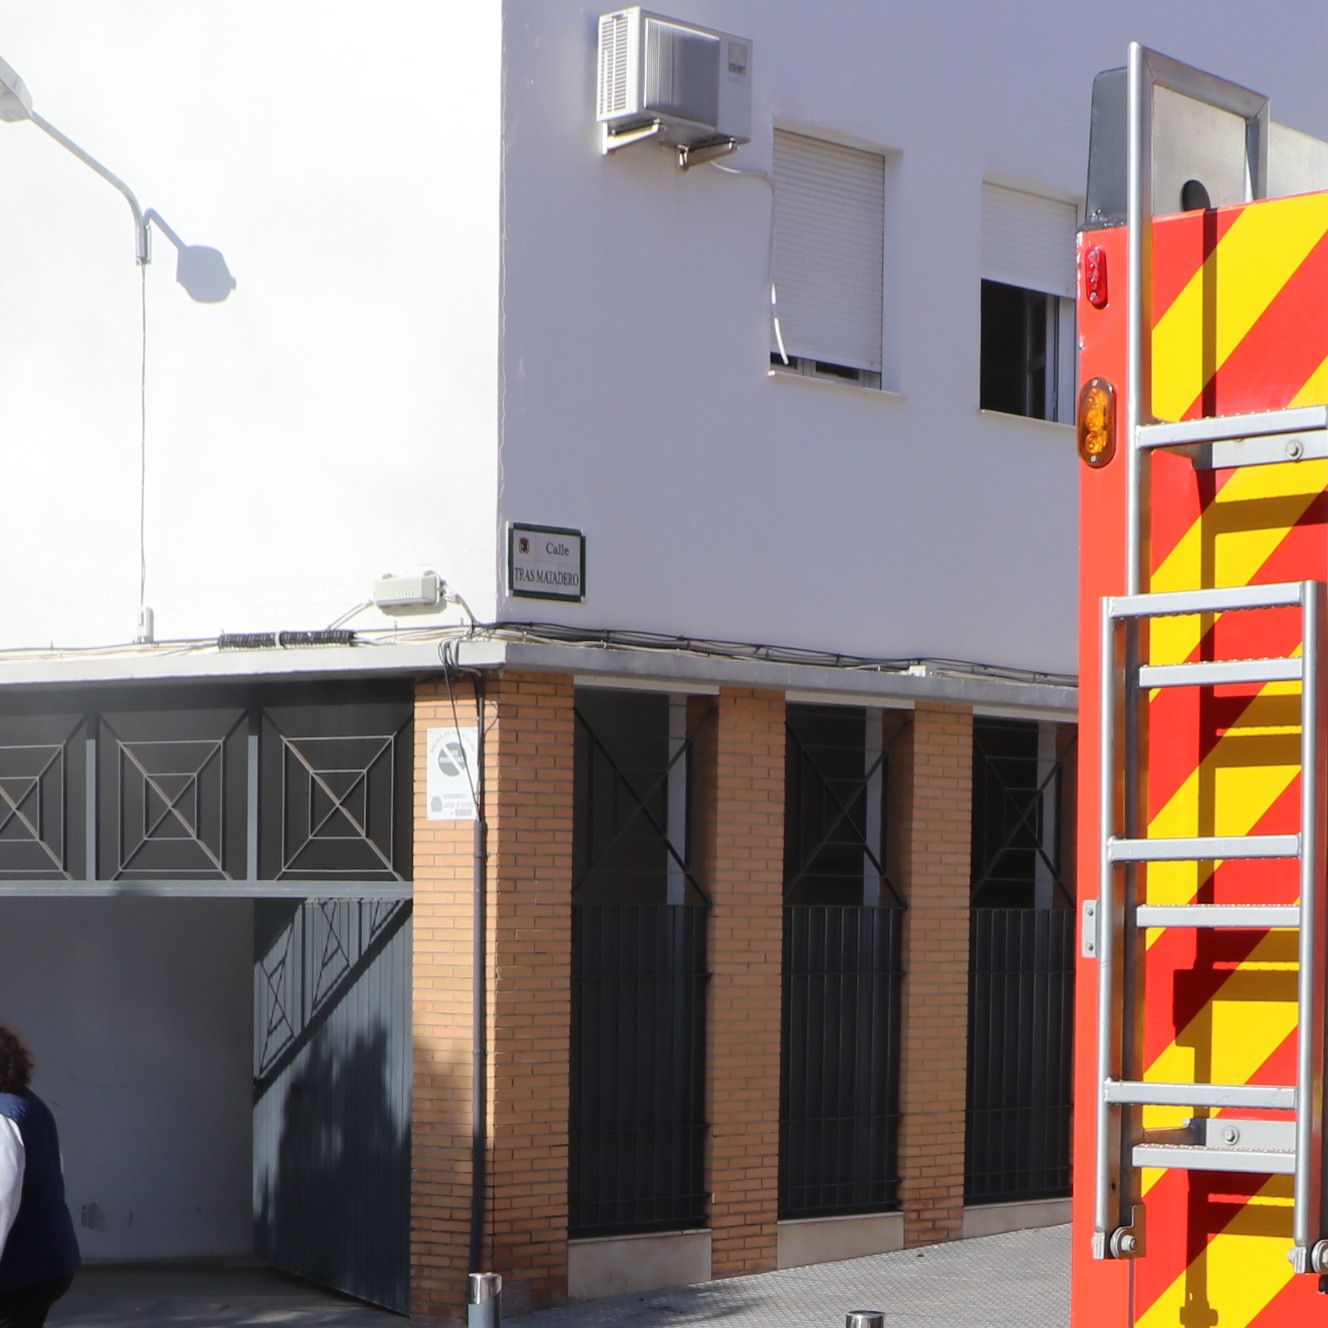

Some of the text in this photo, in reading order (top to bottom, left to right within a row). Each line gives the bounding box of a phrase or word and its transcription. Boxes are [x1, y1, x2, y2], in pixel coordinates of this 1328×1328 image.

[545, 541, 570, 556] Calle
[514, 567, 580, 586] TRAS MATADERO
